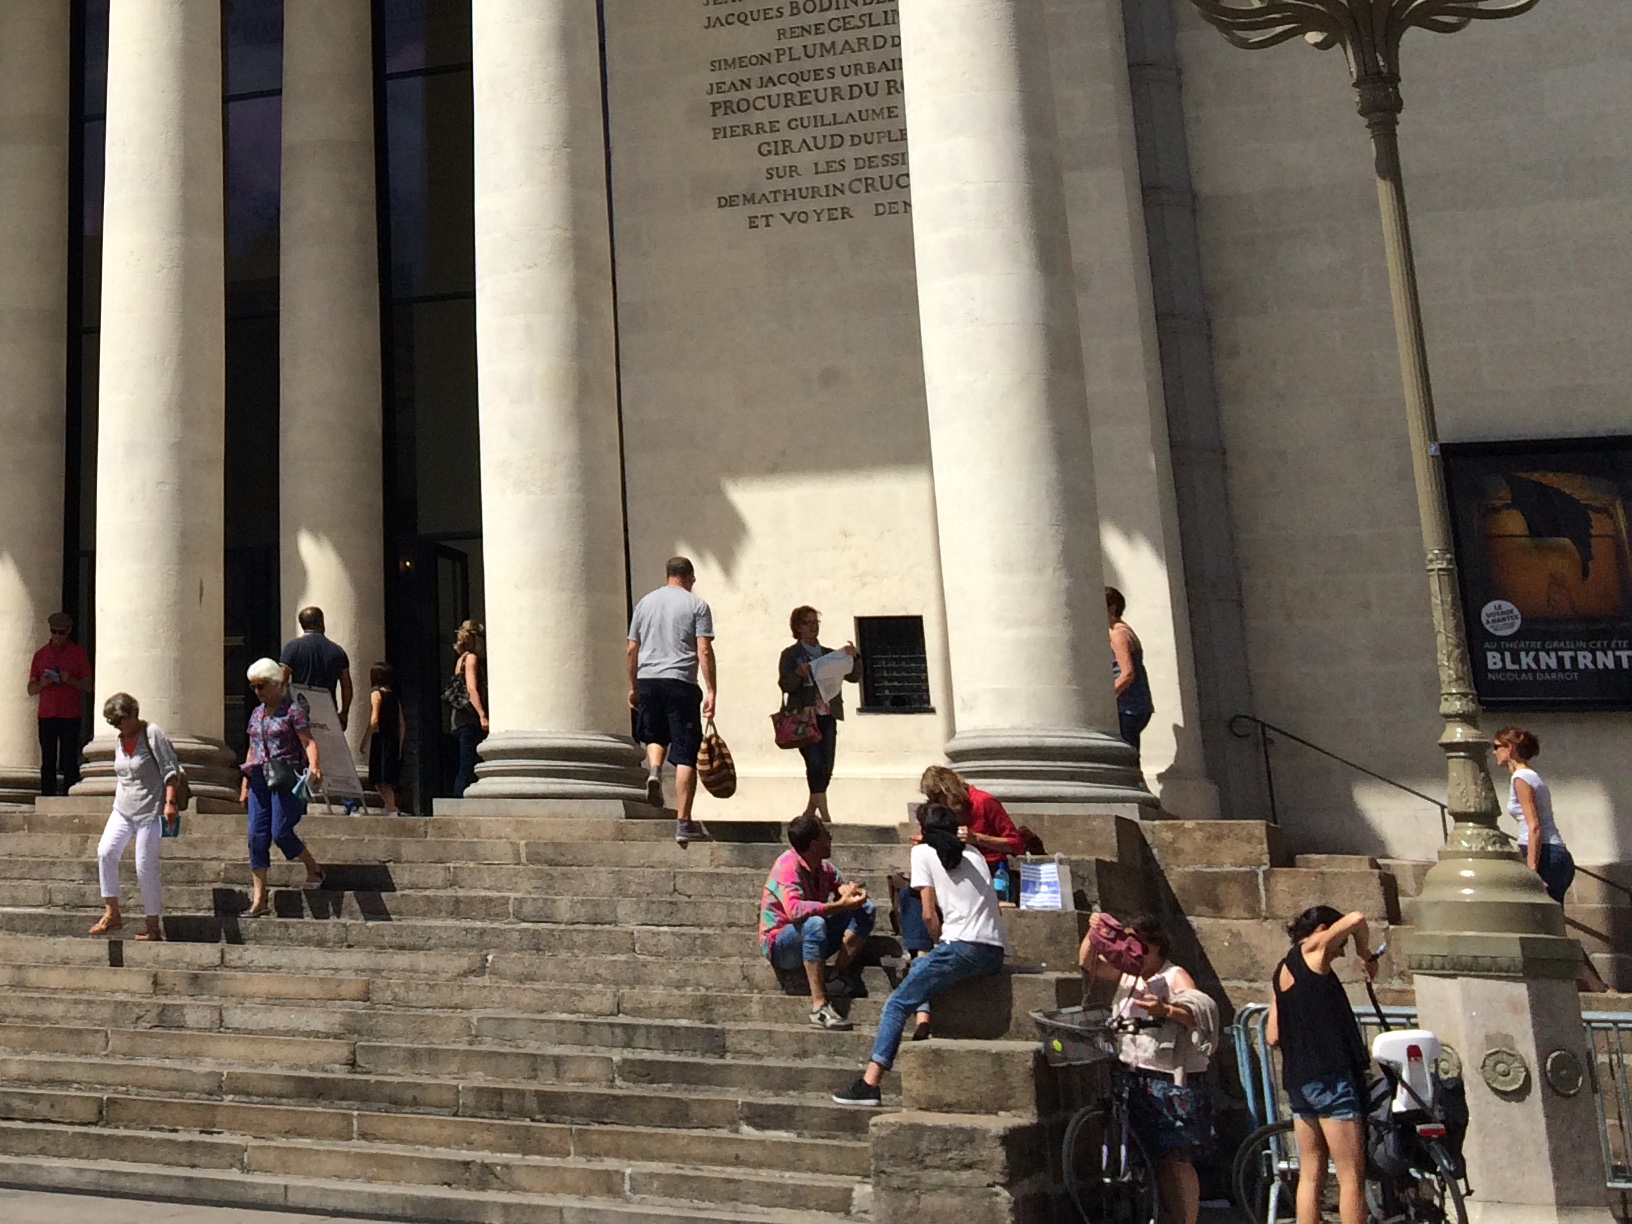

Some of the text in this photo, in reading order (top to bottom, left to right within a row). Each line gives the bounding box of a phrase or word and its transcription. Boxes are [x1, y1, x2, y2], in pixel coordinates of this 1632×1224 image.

[703, 6, 784, 30] JACQUES
[777, 22, 825, 41] RENE
[709, 52, 772, 72] SIMEON
[774, 34, 888, 64] PLUMARD
[706, 77, 752, 96] JEAN
[756, 66, 836, 89] JACQUES
[709, 86, 846, 118] PROCUREUR
[847, 81, 880, 101] DU
[712, 105, 899, 140] PIERRE GUILLAUME
[757, 133, 845, 157] GIRAUD
[765, 164, 802, 180] SUR
[814, 159, 846, 175] LES
[717, 194, 740, 209] DE
[742, 182, 845, 206] MATHURIN
[747, 214, 774, 229] ET
[779, 207, 854, 225] VOYER
[1486, 650, 1632, 670] BLKNTRNT
